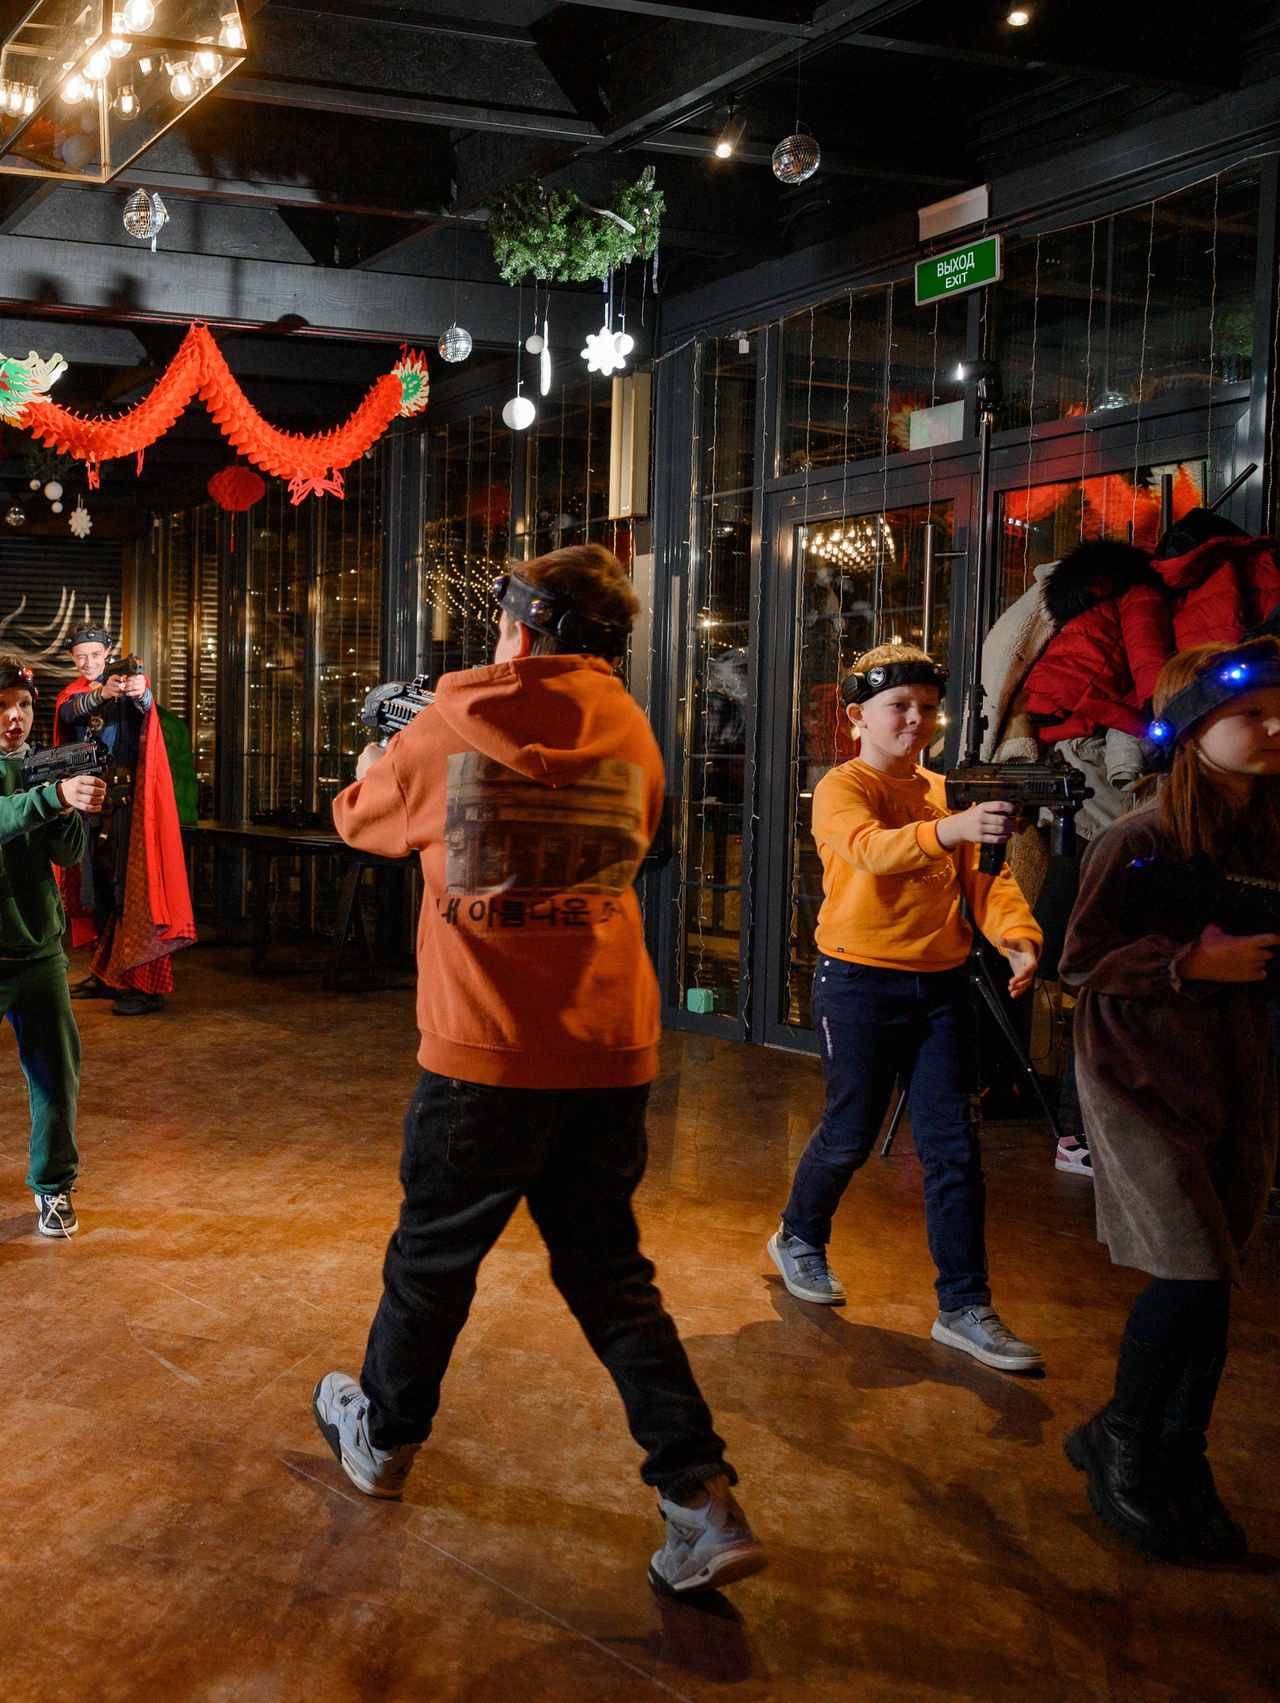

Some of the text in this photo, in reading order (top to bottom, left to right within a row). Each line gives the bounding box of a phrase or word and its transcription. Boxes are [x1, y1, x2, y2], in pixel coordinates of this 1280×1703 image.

[937, 251, 975, 278] ВЫХОД
[945, 271, 968, 289] EXIT
[469, 897, 591, 928] 아름다운
